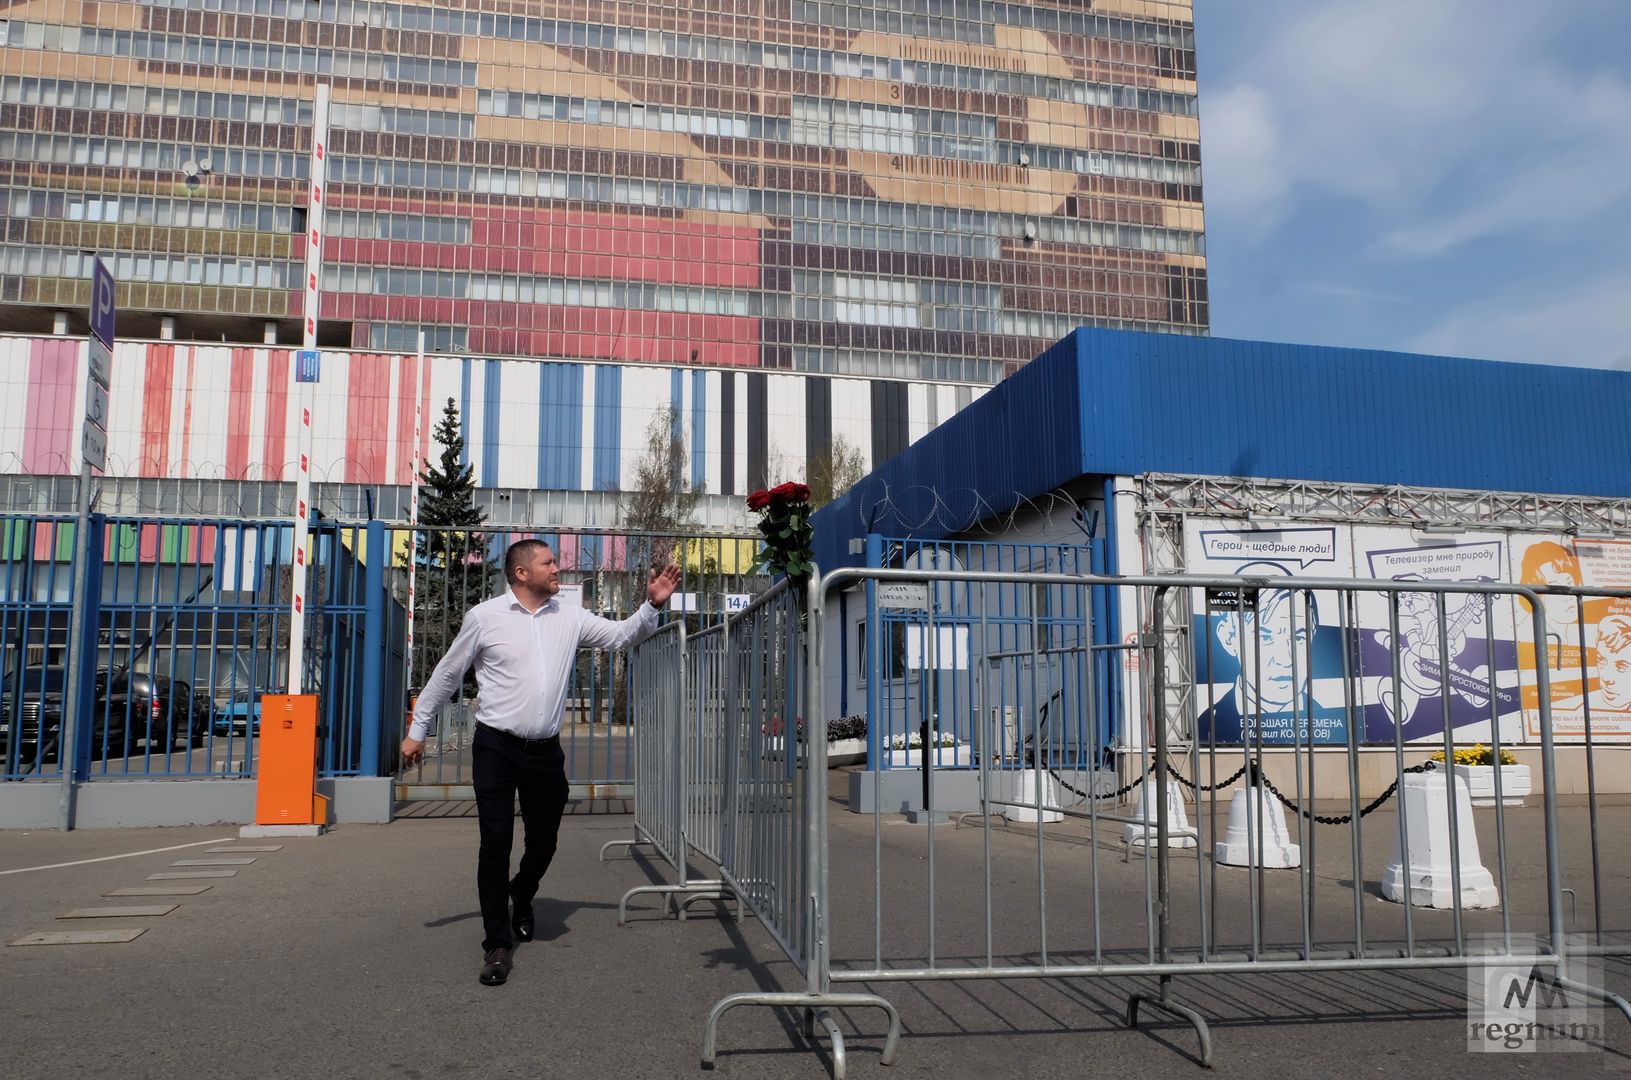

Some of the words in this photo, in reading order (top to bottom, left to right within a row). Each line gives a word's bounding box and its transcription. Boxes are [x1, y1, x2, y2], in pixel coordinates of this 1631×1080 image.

[98, 271, 111, 329] P
[1210, 539, 1243, 552] Герои
[1252, 541, 1296, 554] щедрые
[1298, 543, 1331, 554] люди!
[1436, 553, 1454, 562] мне
[1455, 549, 1495, 561] природу
[1422, 564, 1462, 575] заменил
[1421, 663, 1442, 677] ЗИМА
[1448, 673, 1512, 702] ПРОСТОКВАИНО
